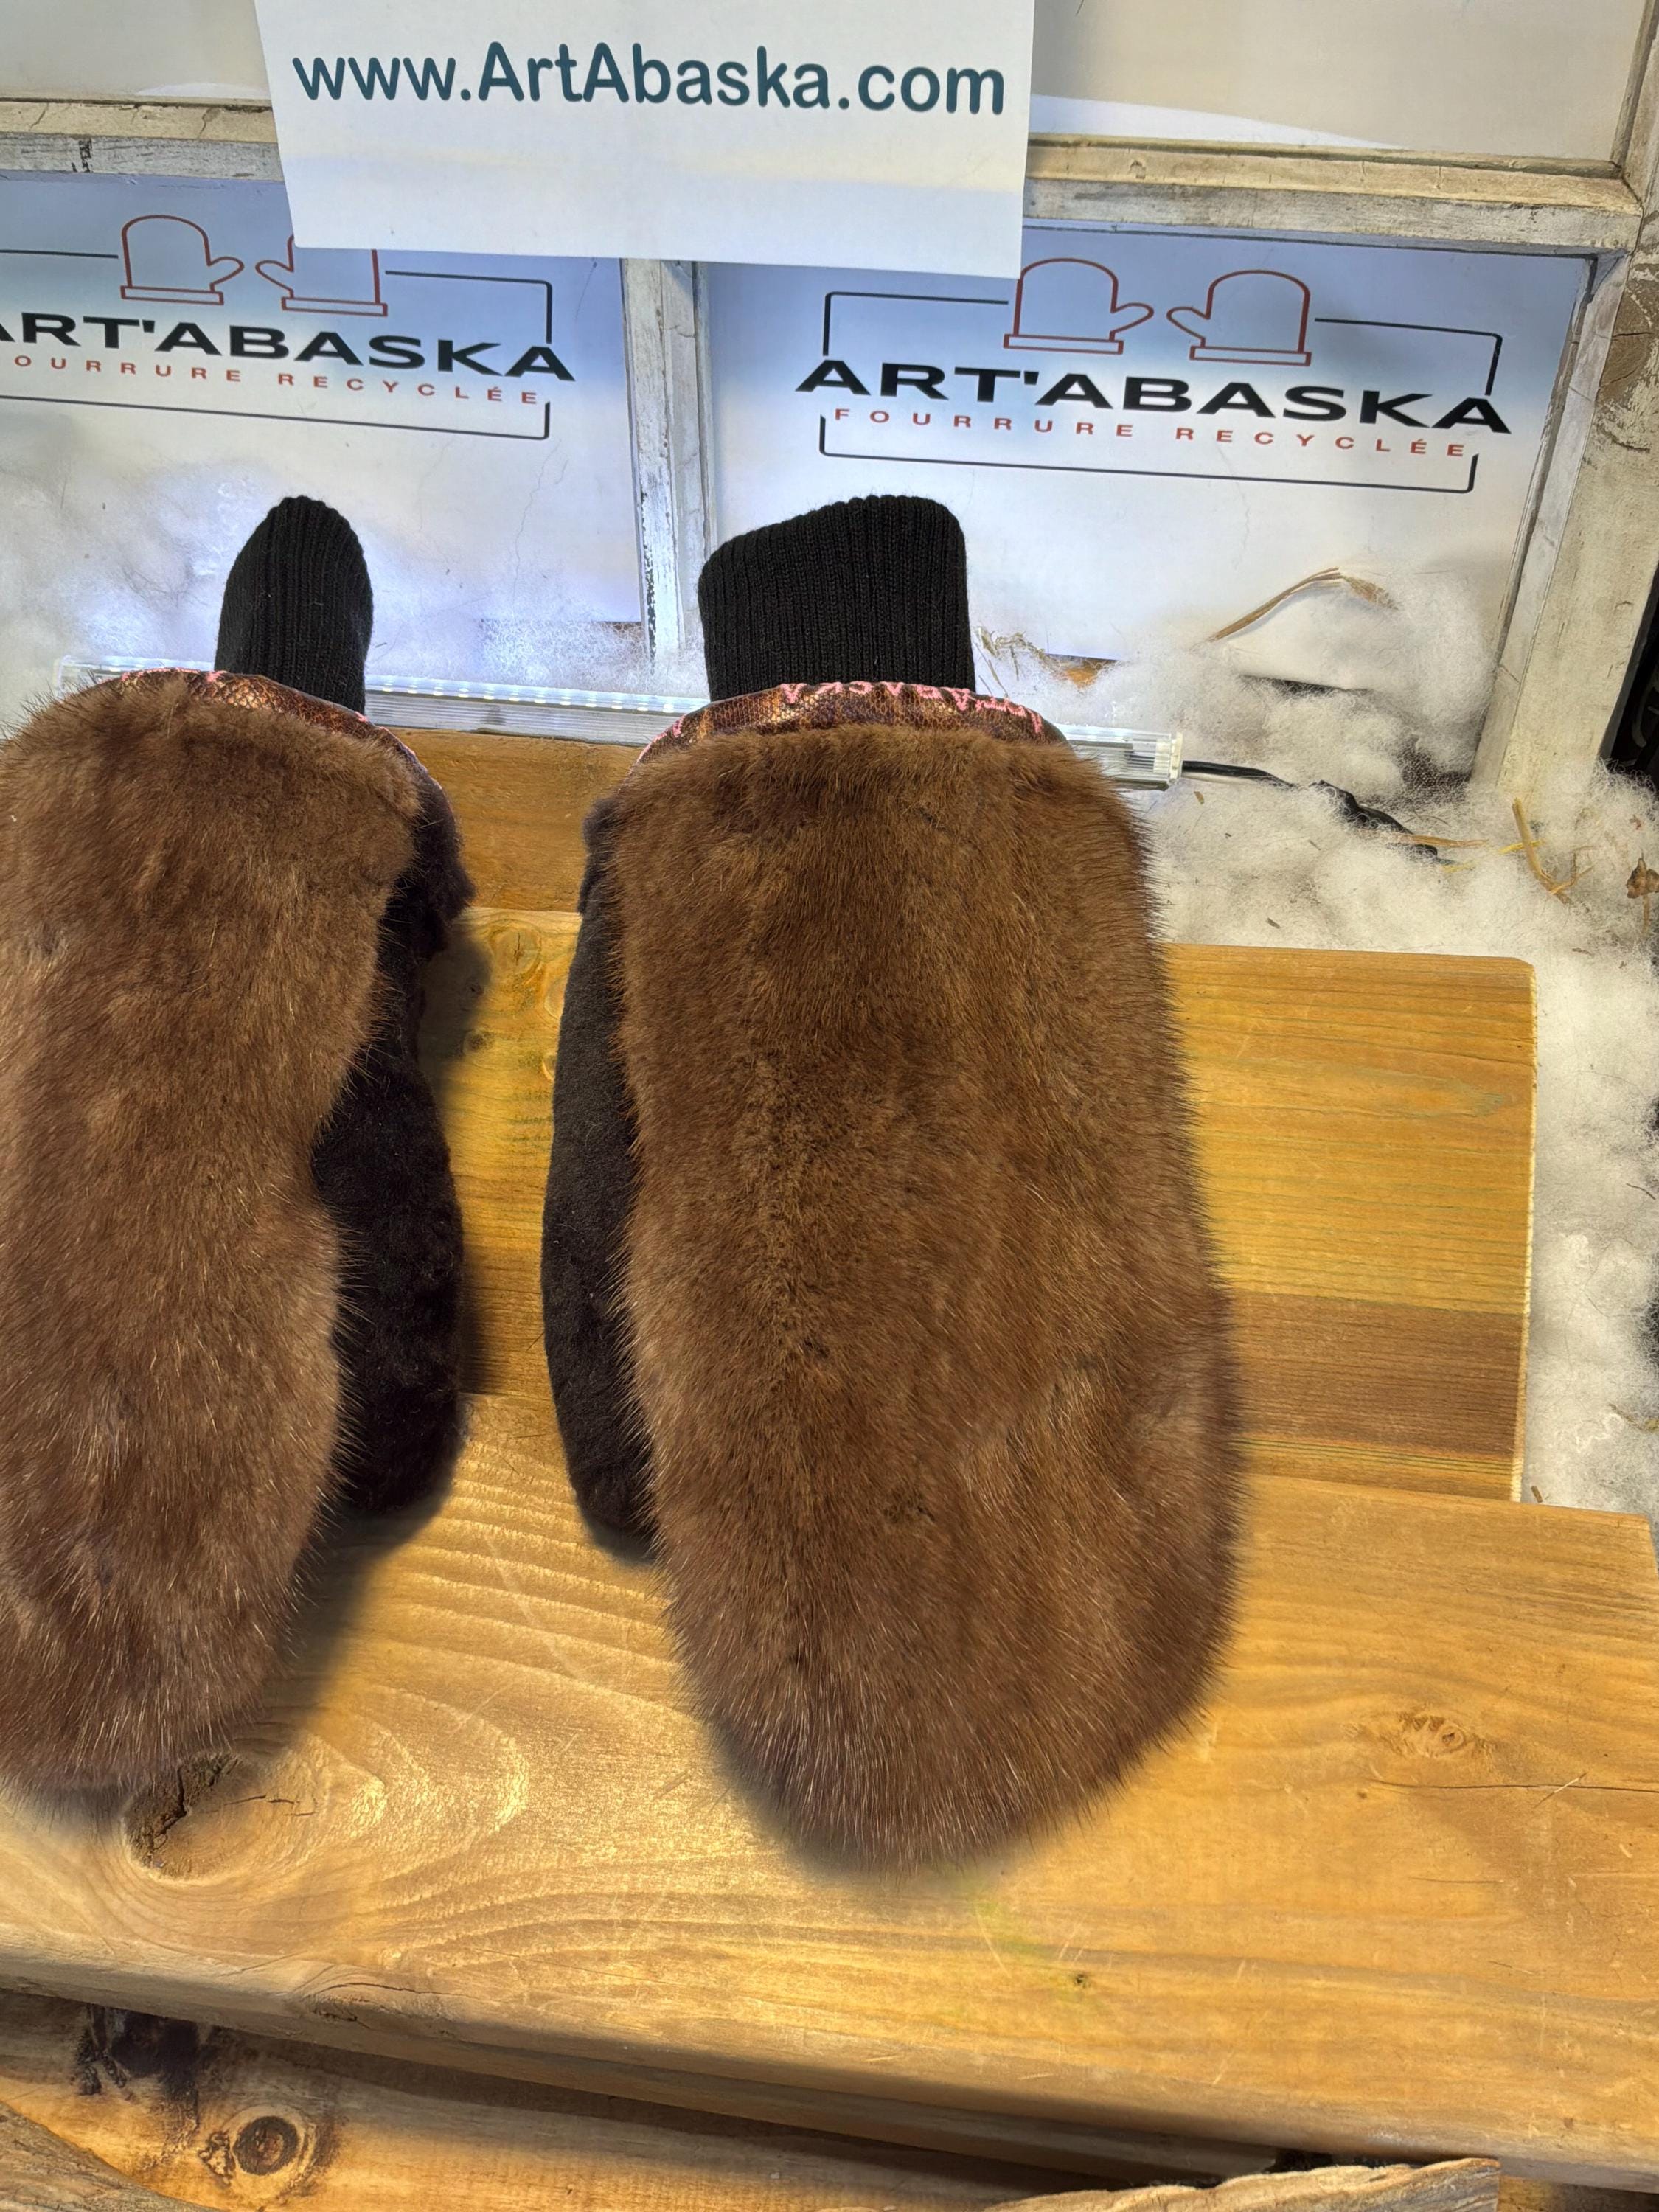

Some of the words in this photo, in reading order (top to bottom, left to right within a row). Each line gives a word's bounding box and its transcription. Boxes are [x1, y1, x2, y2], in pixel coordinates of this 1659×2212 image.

[292, 41, 1005, 115] www.ArtAbaska.com
[0, 312, 574, 381] RT'ABASKA
[278, 372, 538, 404] RECYCLÉE
[796, 359, 1512, 434] ART'ABASKA
[835, 408, 1133, 437] FOURRURE
[1175, 426, 1465, 457] RECYCLÉE
